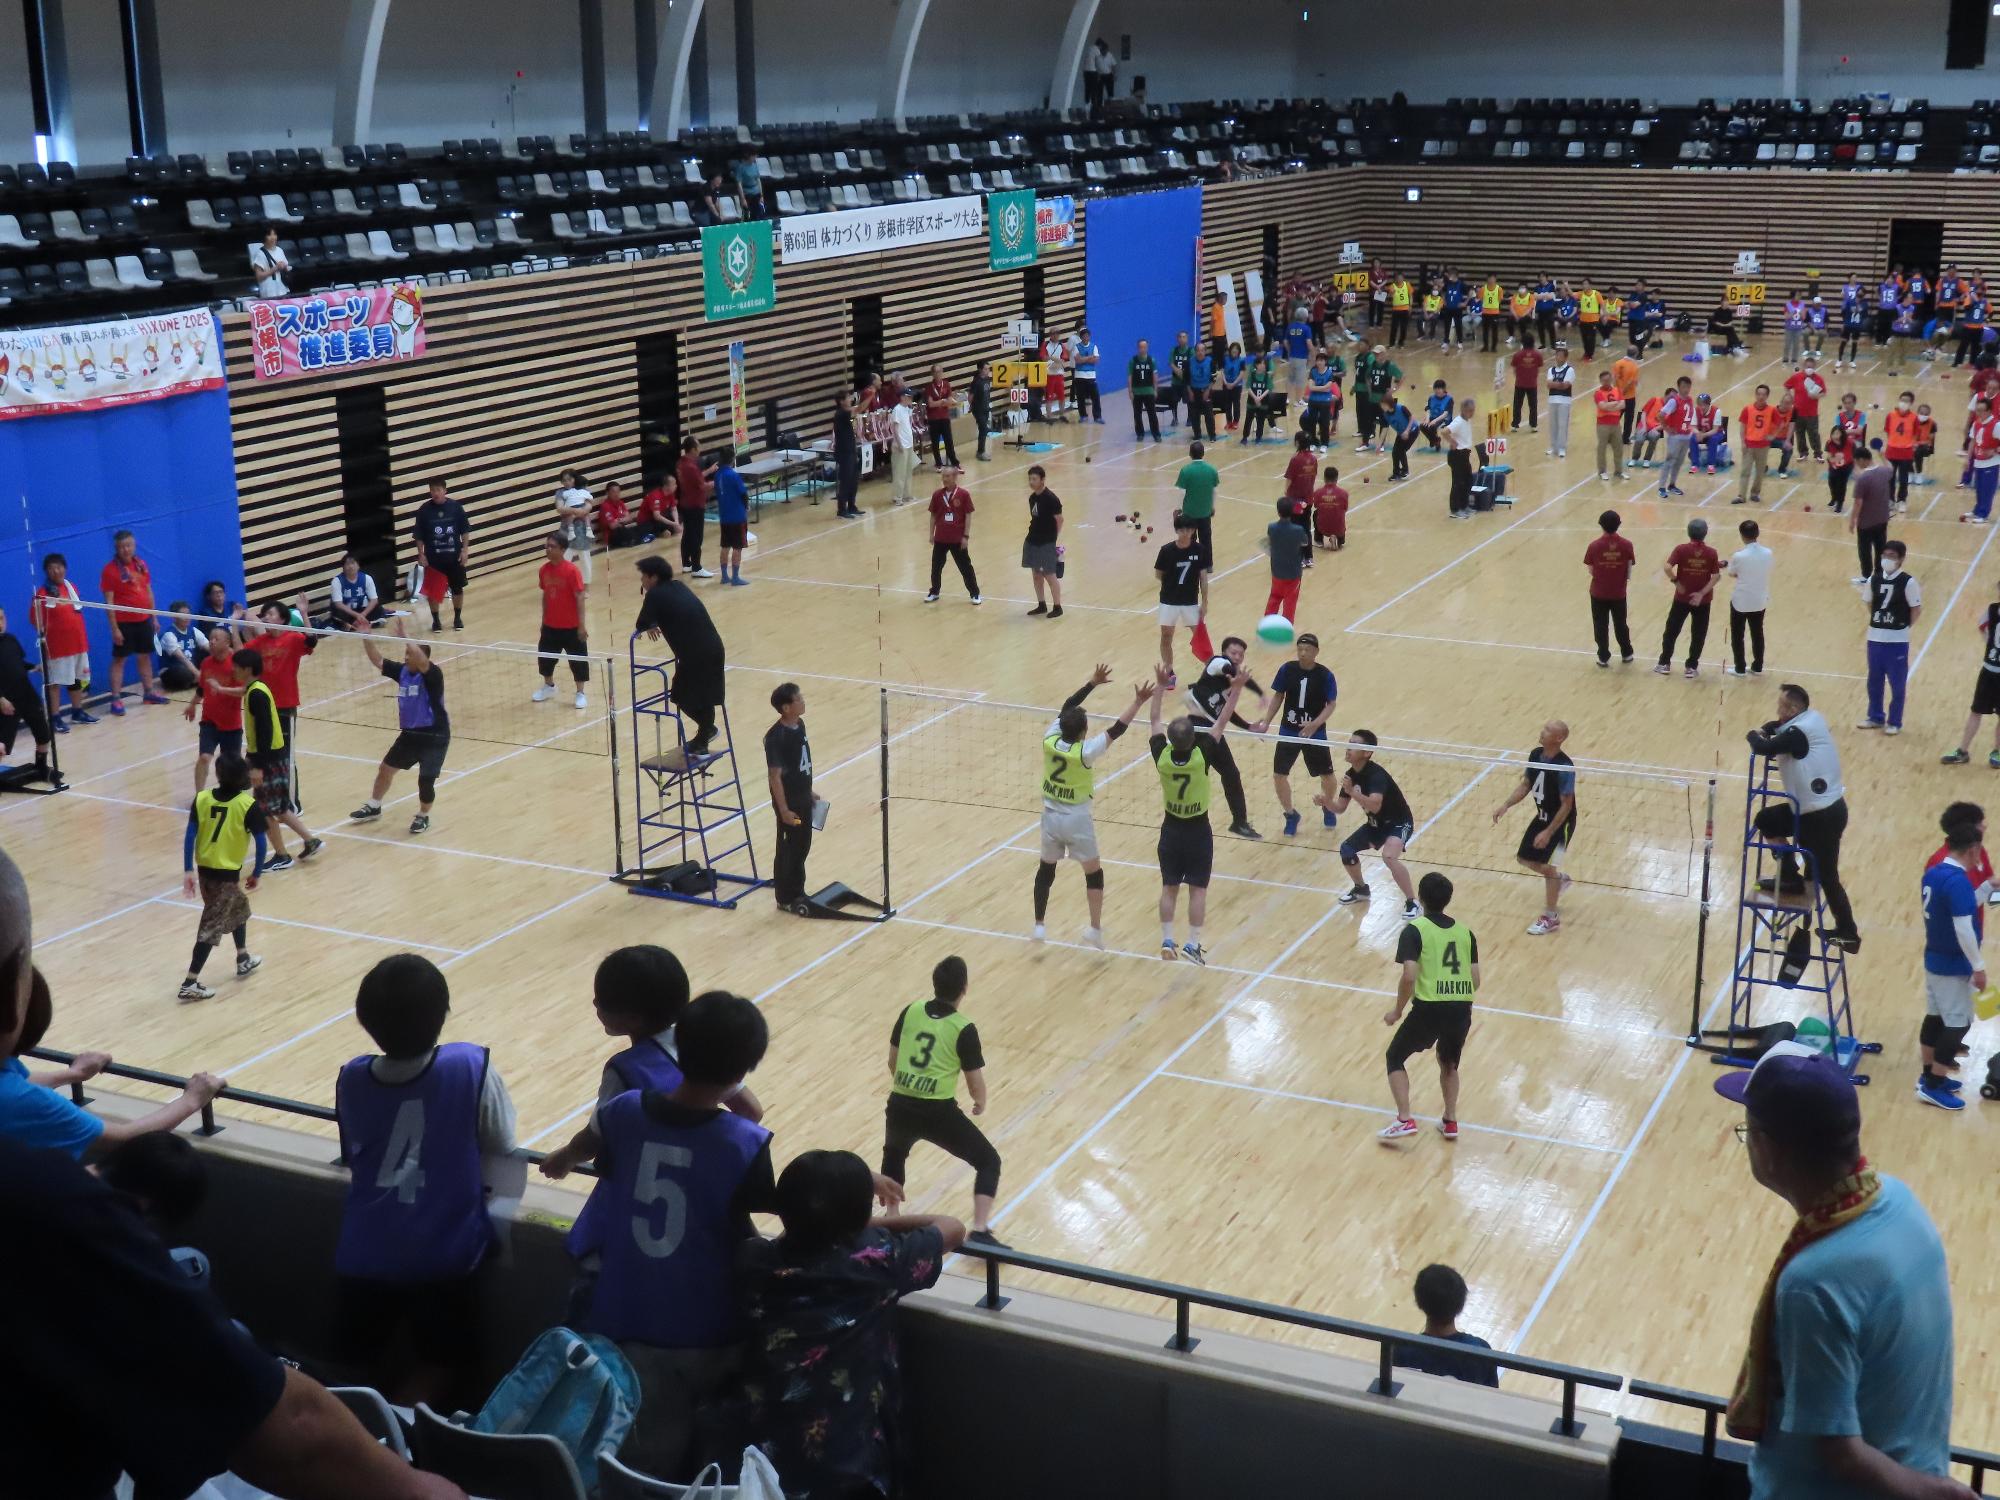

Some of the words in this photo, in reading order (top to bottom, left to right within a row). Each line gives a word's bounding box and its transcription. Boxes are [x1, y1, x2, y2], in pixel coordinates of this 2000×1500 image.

[783, 229, 817, 253] 第63回
[821, 223, 872, 248] 体力づくり
[876, 208, 980, 240] 彦根市学区スポーツ大会
[1359, 275, 1366, 288] 2
[1730, 287, 1738, 301] 6
[1755, 286, 1762, 300] 2
[184, 312, 210, 329] 2025
[276, 296, 371, 336] スポーツ
[250, 303, 283, 376] 彦根市
[299, 324, 394, 370] 推進委員
[997, 364, 1007, 383] 2
[1034, 363, 1040, 383] 1
[1683, 404, 1691, 422] 2
[1755, 415, 1764, 429] 5
[1895, 423, 1904, 434] 4
[1176, 561, 1191, 585] 7
[1880, 583, 1895, 610] 7
[1298, 677, 1308, 709] 1
[799, 744, 811, 776] 4
[1049, 755, 1068, 784] 2
[1172, 773, 1191, 800] 7
[1531, 770, 1546, 805] 4
[210, 805, 229, 843] 7
[1922, 885, 1932, 920] 2
[1442, 941, 1460, 975] 4
[909, 1031, 937, 1069] 3
[375, 1098, 425, 1204] 4
[630, 1140, 693, 1259] 5
